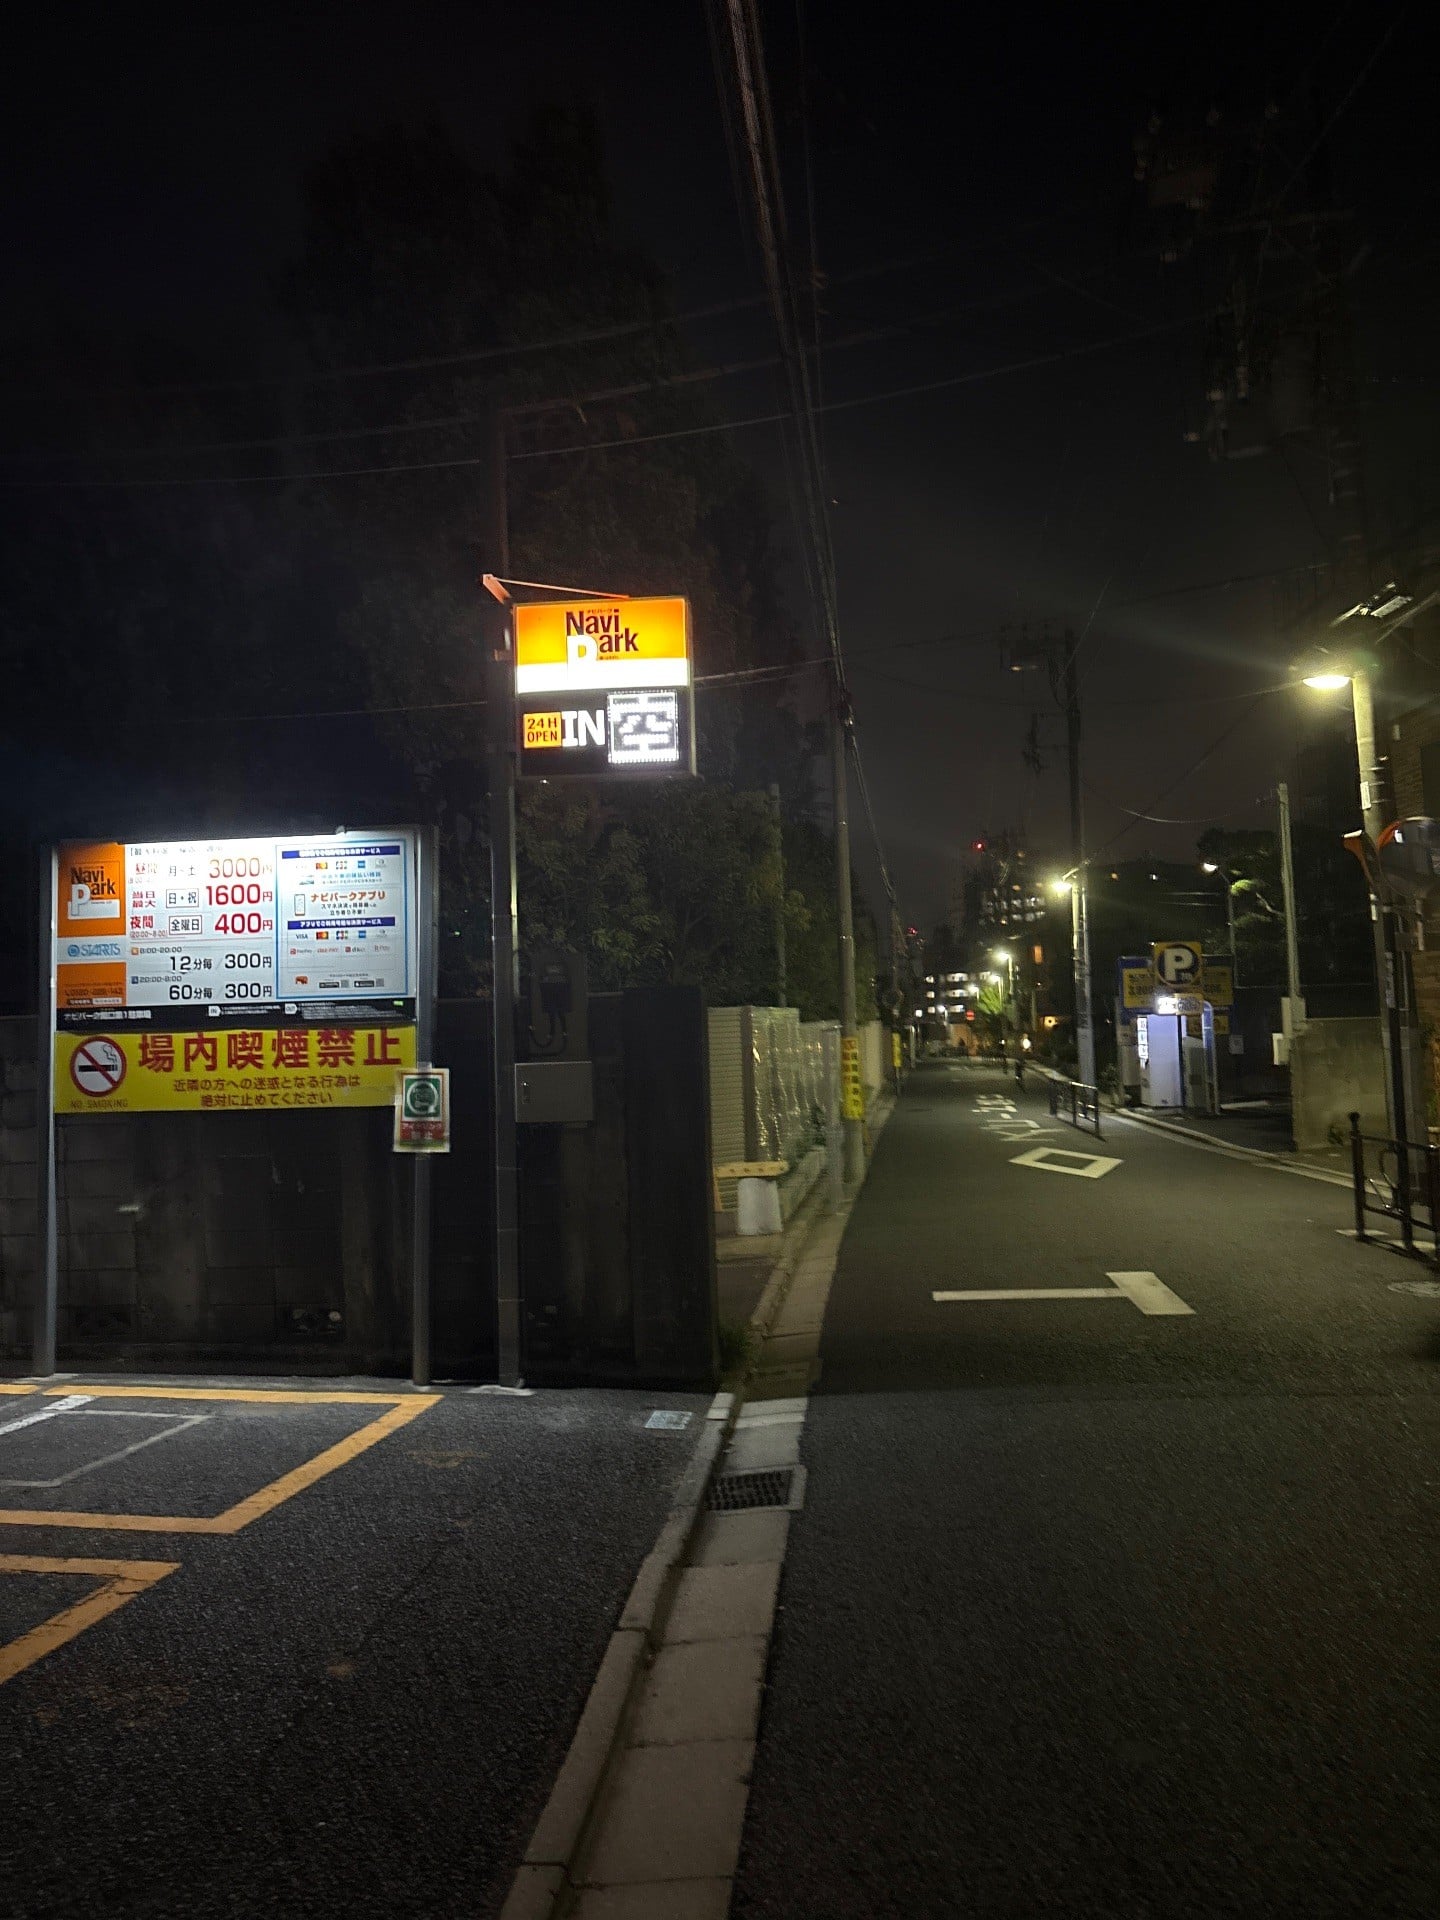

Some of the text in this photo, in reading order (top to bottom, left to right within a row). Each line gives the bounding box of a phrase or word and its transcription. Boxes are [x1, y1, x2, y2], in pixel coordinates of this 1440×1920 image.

[566, 609, 620, 635] Navi
[527, 730, 558, 742] OPEN
[562, 710, 606, 747] IN
[609, 690, 679, 763] 空
[71, 866, 105, 885] Navi
[72, 878, 116, 917] Park
[310, 890, 386, 903] ナビパークアプリ
[130, 915, 154, 929] 夜間
[215, 912, 273, 935] 400円
[138, 1029, 402, 1073] 場内喫煙禁止
[174, 1075, 360, 1092] 近隣の方への迷惑となる行為は
[201, 1092, 333, 1108] 絶対に止めてください
